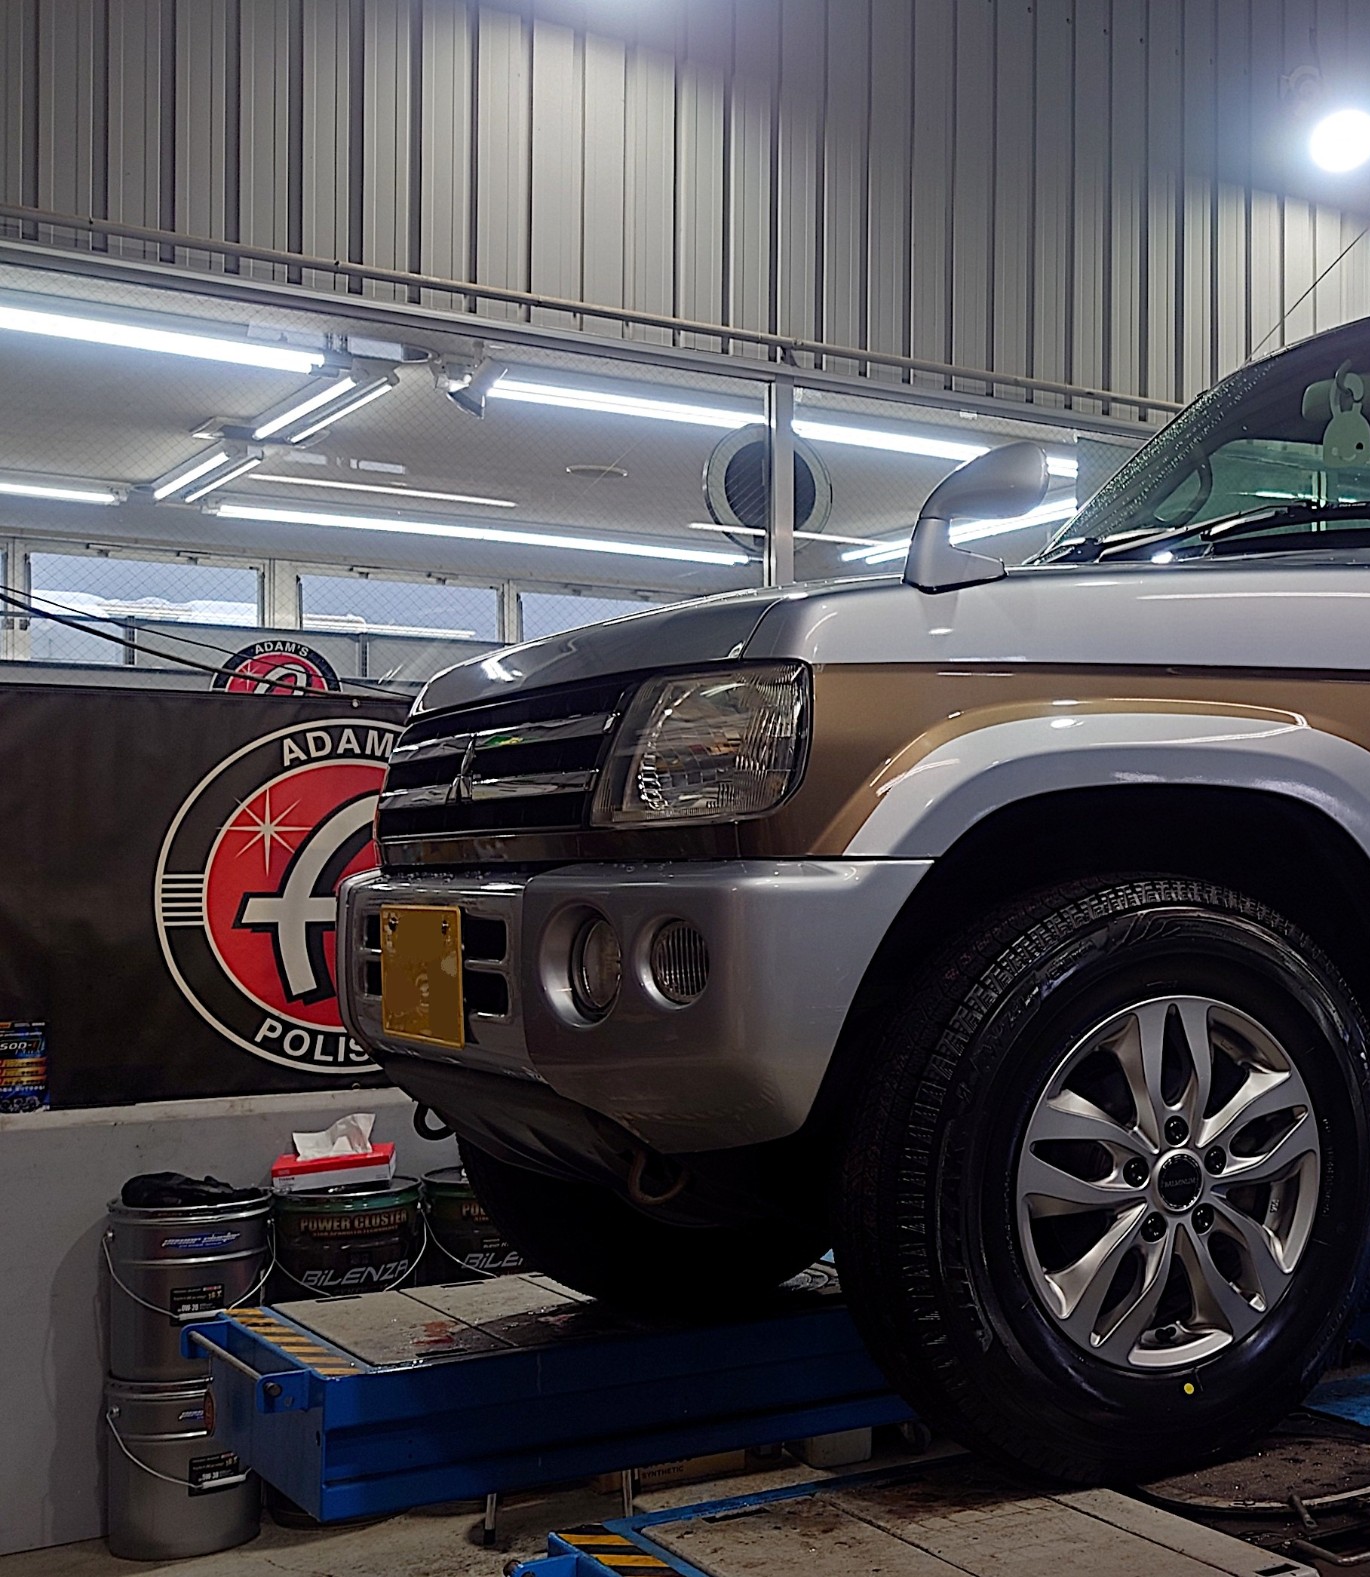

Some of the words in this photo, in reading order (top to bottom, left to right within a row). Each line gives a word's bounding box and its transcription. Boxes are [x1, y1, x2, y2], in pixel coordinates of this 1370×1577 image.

[254, 641, 309, 657] ADAM'S
[299, 1216, 351, 1232] POWER
[353, 1209, 408, 1229] CLUSTER
[642, 1465, 684, 1479] SYNTHETIC
